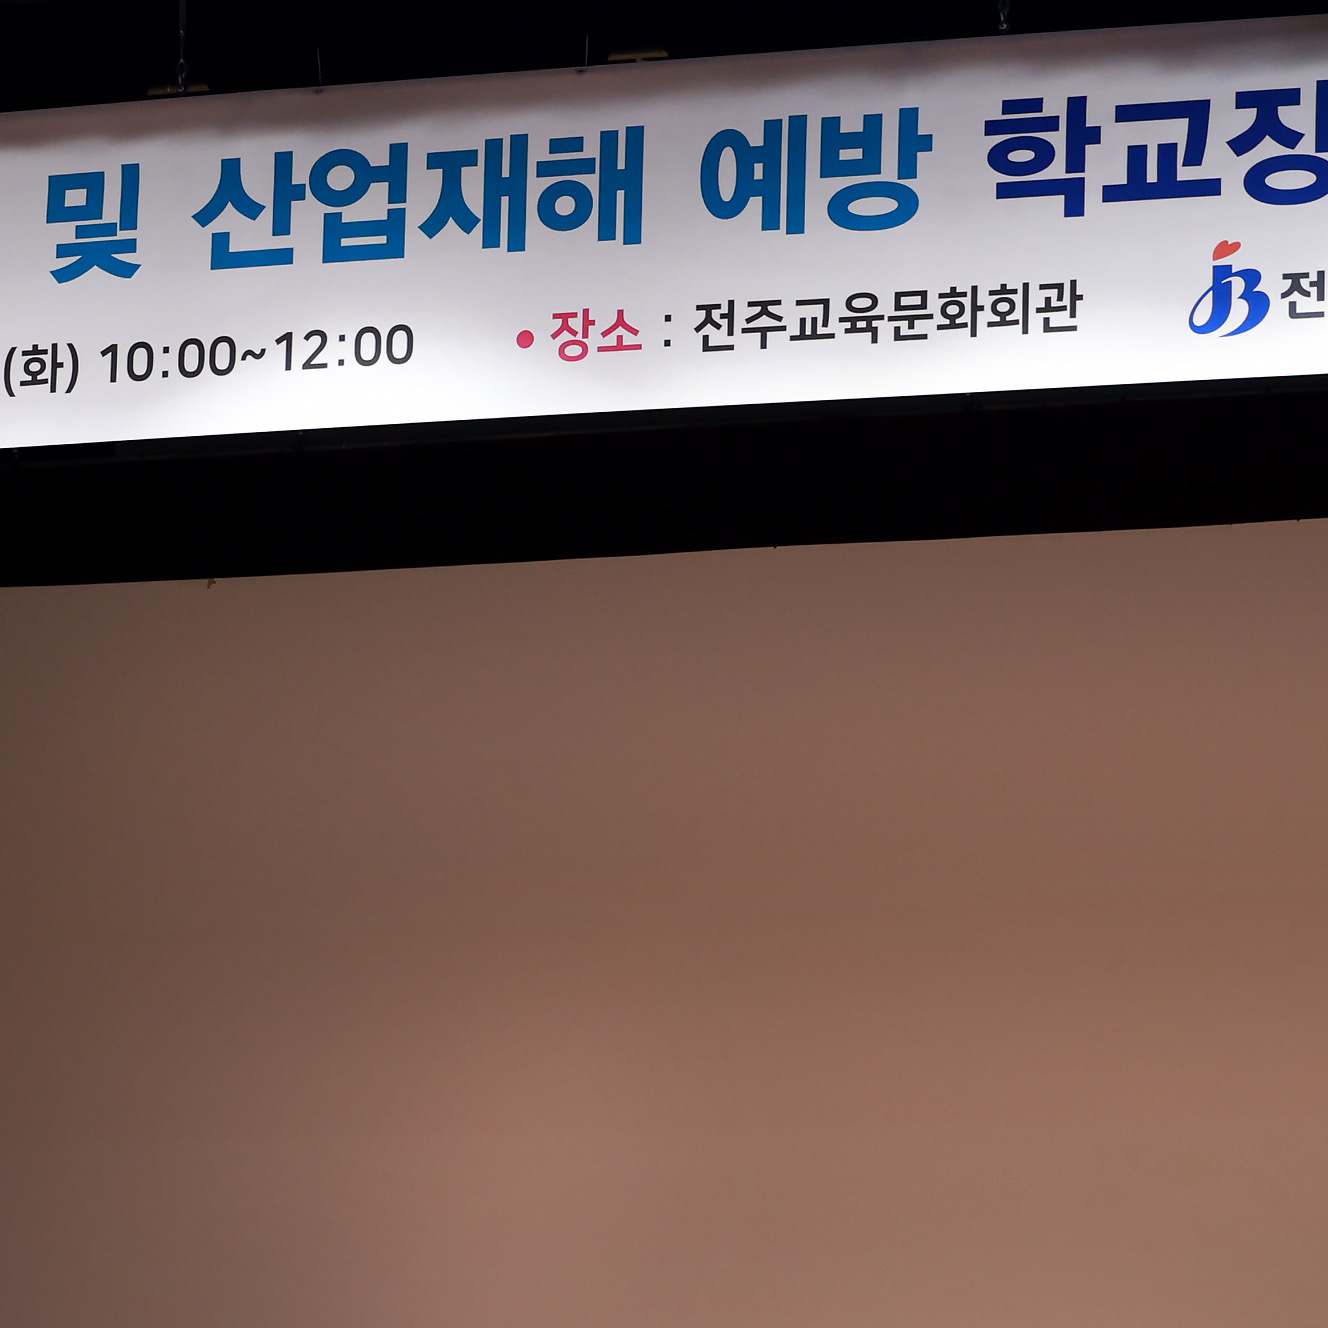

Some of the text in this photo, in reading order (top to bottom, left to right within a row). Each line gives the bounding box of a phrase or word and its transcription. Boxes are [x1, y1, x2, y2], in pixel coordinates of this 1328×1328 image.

[45, 162, 142, 285] 및
[190, 124, 645, 271] 산업재해
[699, 106, 934, 236] 예방
[99, 323, 414, 384] 10:00~12:00
[549, 307, 643, 363] 장소
[693, 278, 1084, 353] 전주교육문화회관
